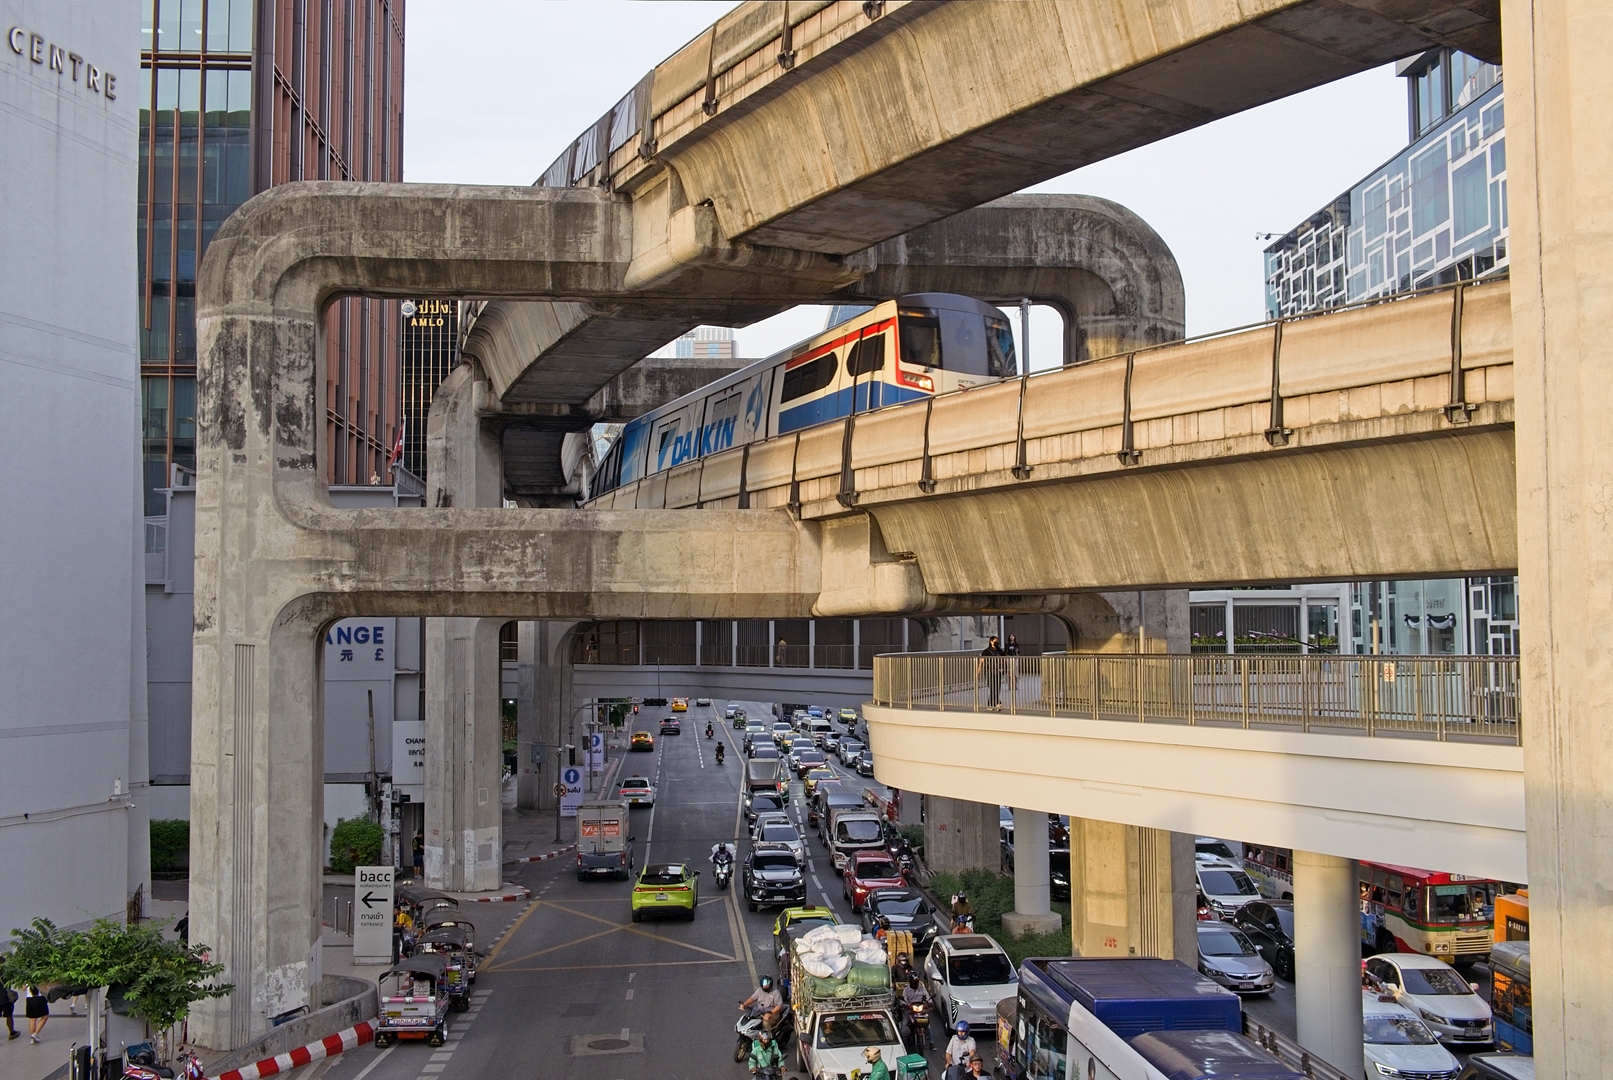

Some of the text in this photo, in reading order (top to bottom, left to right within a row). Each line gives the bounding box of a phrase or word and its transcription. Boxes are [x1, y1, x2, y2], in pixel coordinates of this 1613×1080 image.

[9, 26, 117, 100] CENTRE
[419, 300, 452, 314] ปปง.
[411, 318, 444, 326] AMLO
[671, 415, 738, 467] DAIKIN
[340, 648, 384, 661] 元 £
[360, 871, 391, 882] bacc
